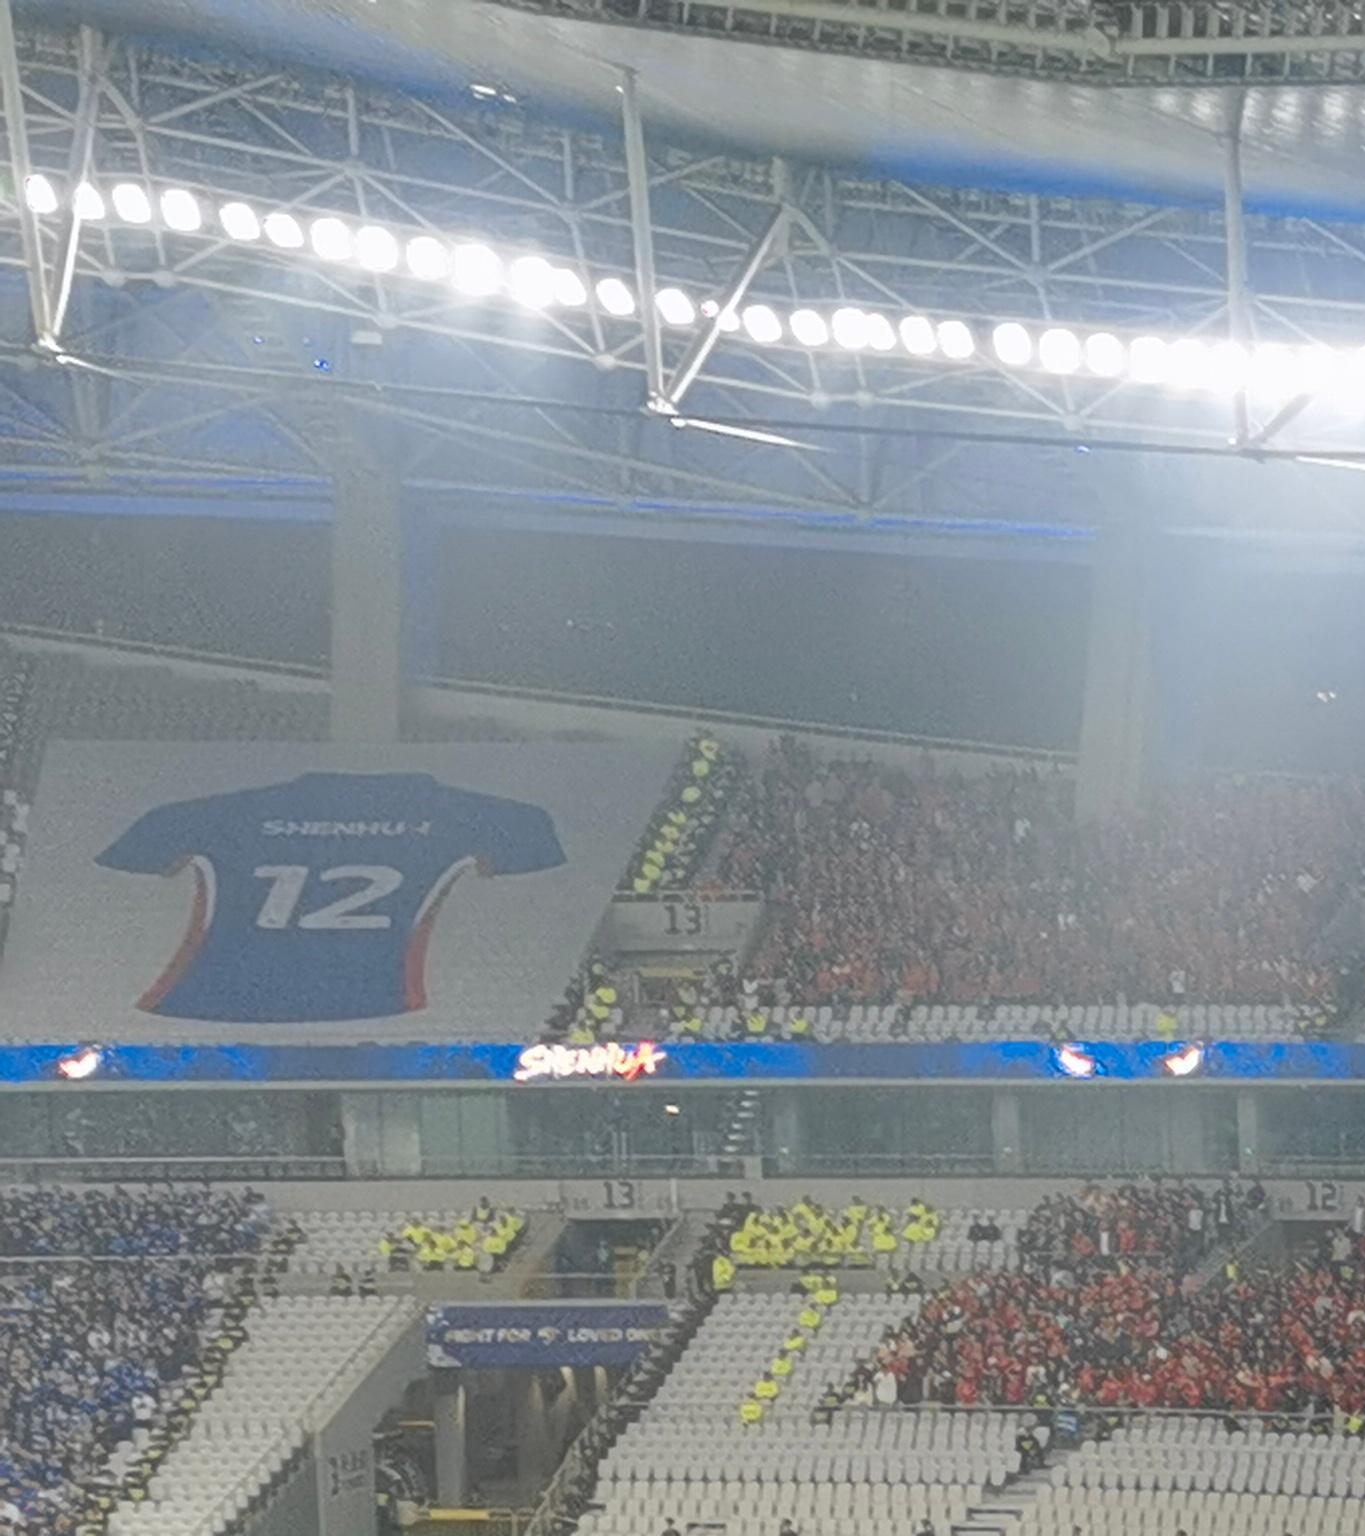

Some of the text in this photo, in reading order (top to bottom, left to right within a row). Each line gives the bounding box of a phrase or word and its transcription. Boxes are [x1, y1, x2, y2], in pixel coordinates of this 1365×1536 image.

[254, 865, 404, 929] 12
[664, 903, 701, 935] 13
[603, 1181, 635, 1209] 13
[1306, 1182, 1339, 1211] 12
